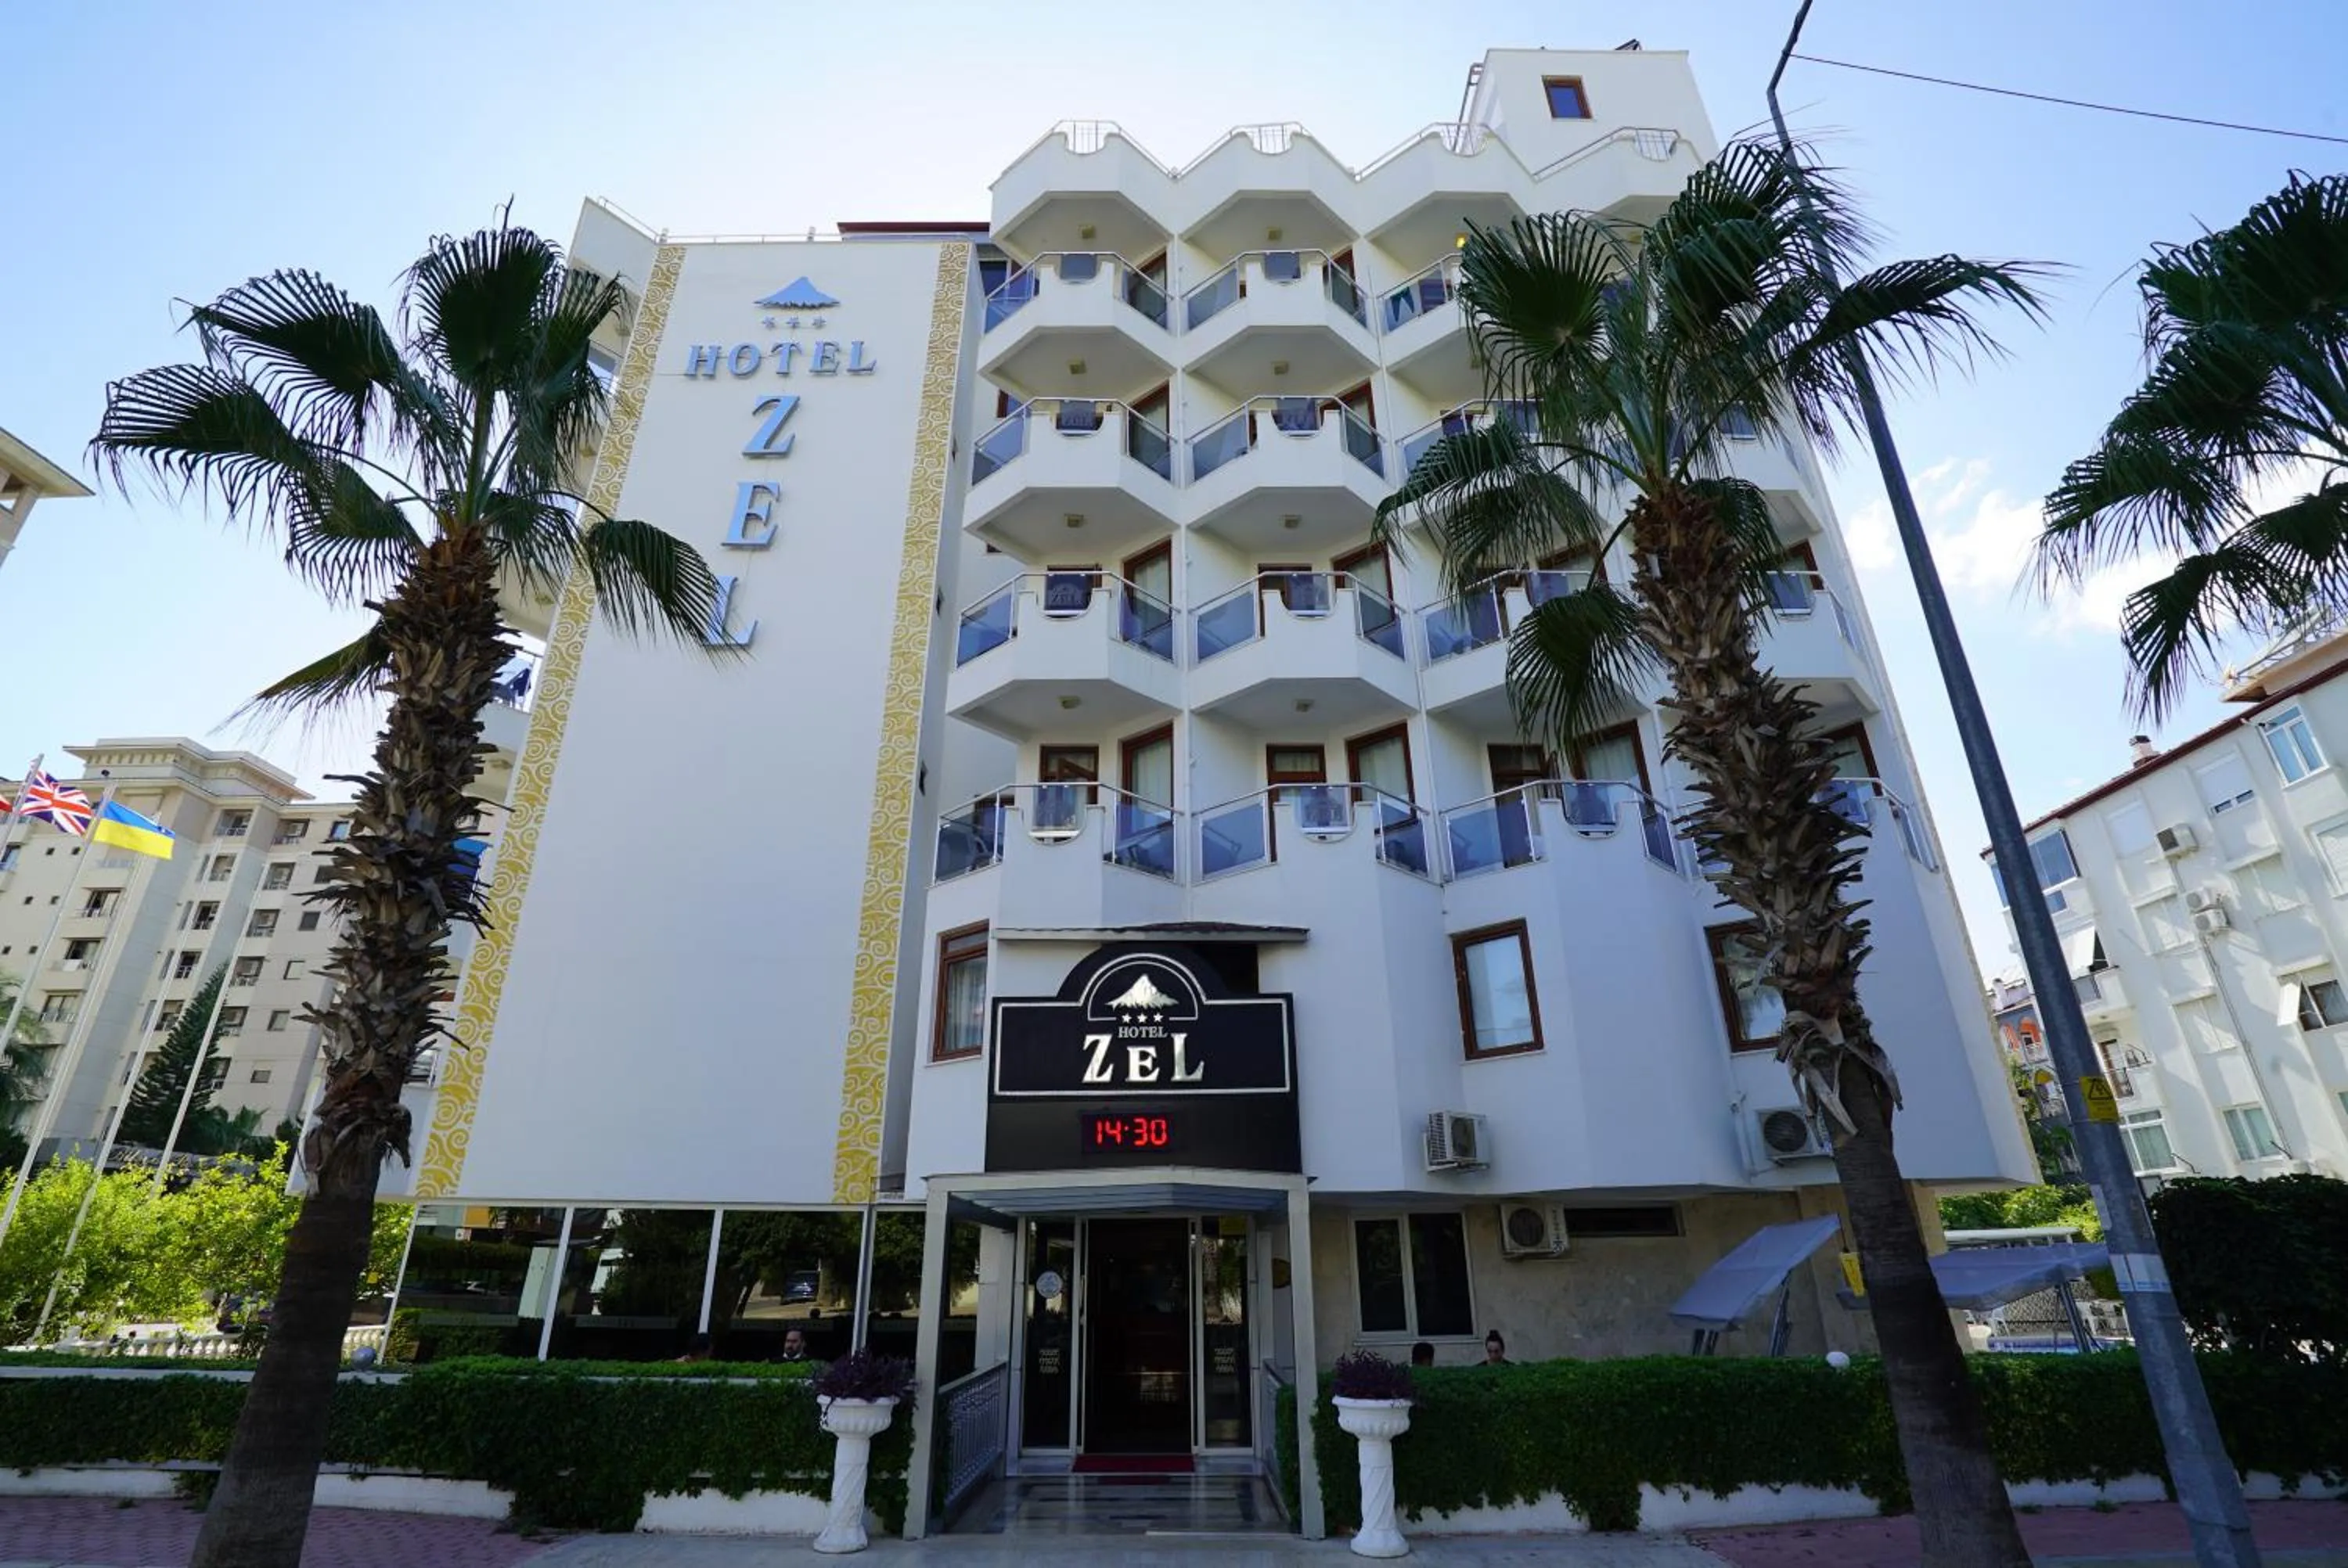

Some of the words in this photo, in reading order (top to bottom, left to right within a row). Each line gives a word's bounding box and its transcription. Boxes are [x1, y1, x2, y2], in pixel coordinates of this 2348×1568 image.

[684, 341, 877, 377] HOTEL
[1118, 1026, 1168, 1038] HOTEL
[1082, 1032, 1205, 1083] ZEL
